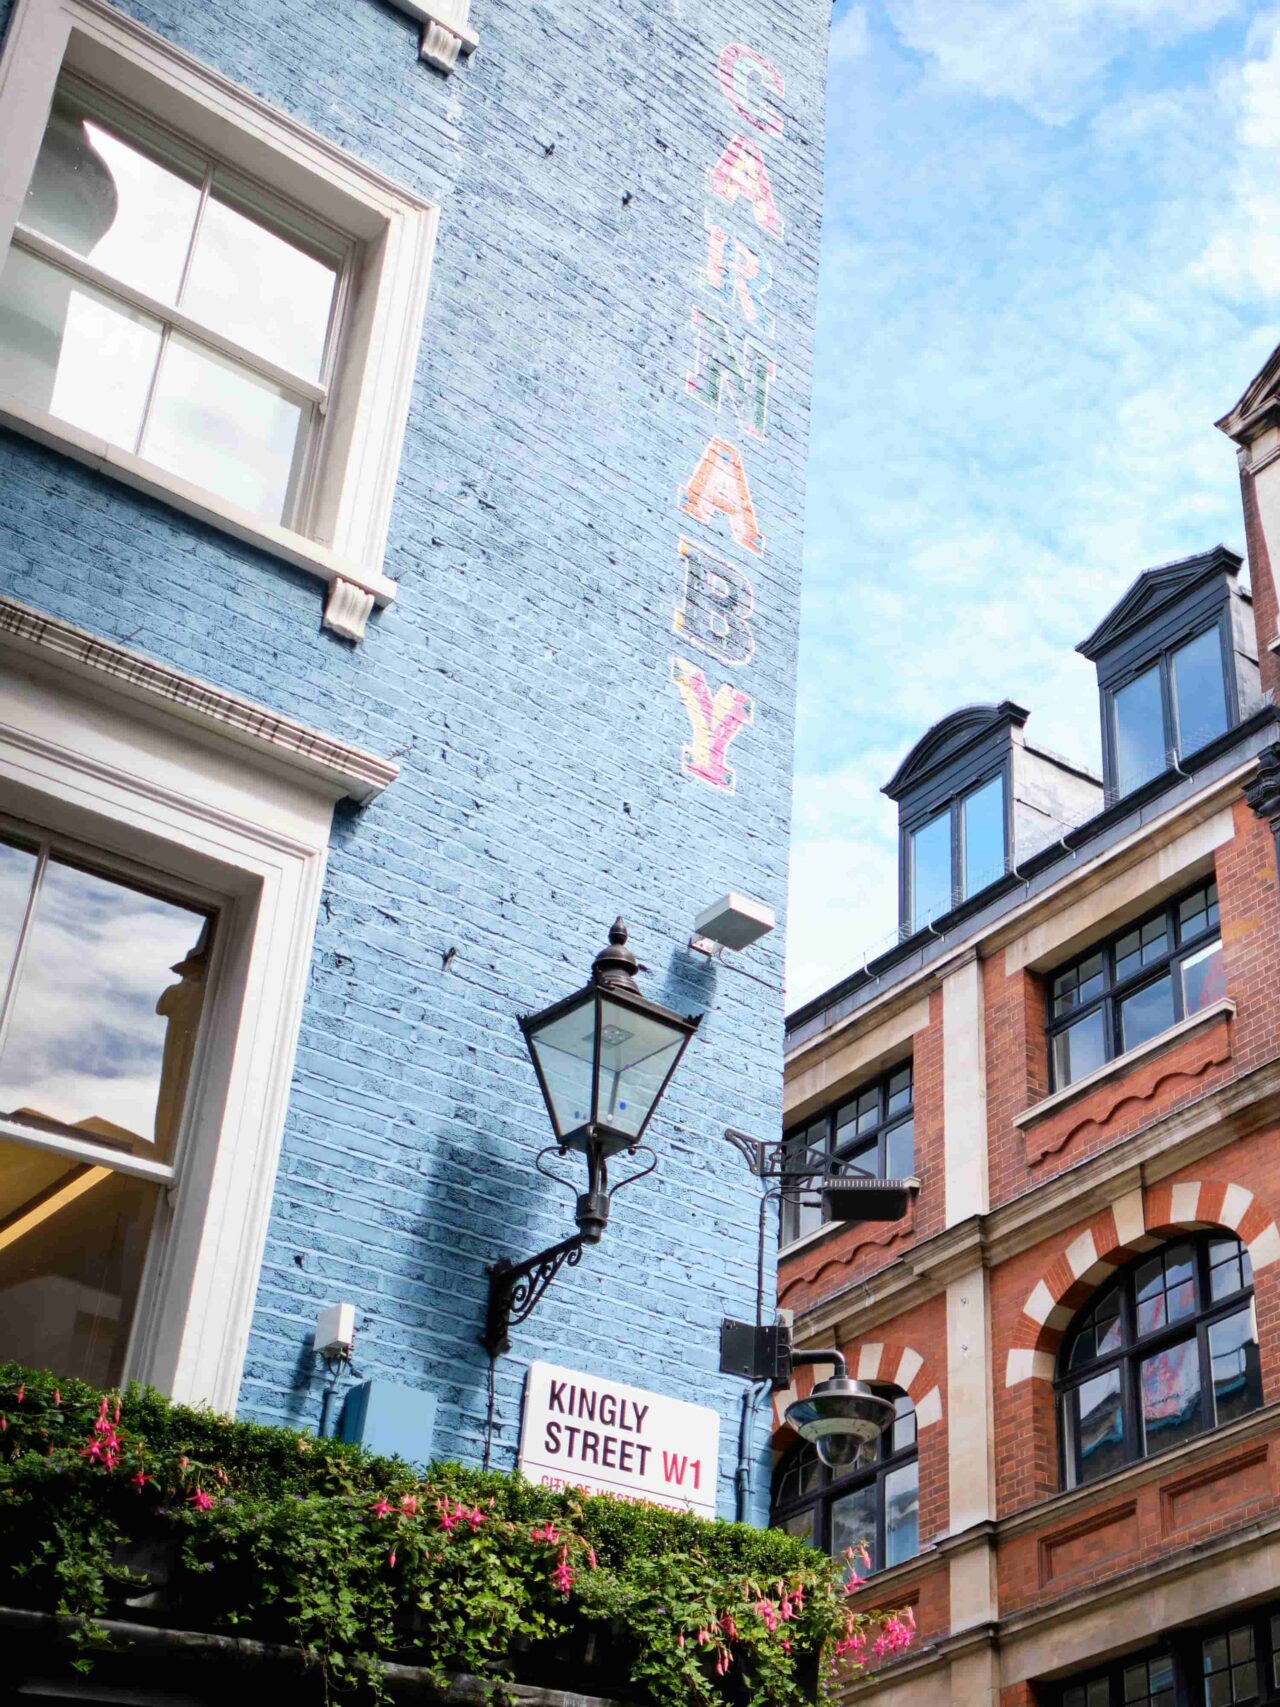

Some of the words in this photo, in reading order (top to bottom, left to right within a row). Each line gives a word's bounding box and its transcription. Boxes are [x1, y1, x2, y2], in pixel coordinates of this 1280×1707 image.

[671, 42, 786, 796] CARNABY
[548, 1379, 650, 1434] KINGLY
[541, 1474, 570, 1493] CITY
[544, 1421, 652, 1476] STREET
[662, 1450, 702, 1490] W1
